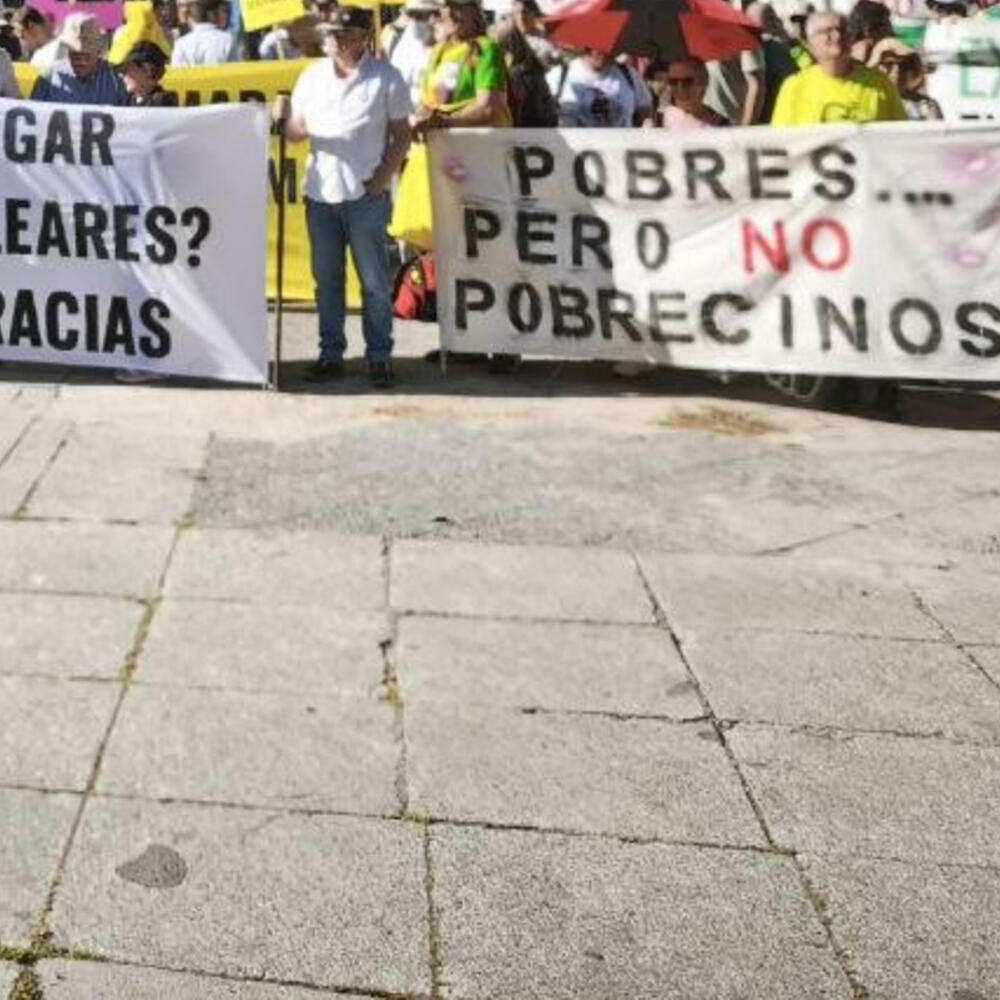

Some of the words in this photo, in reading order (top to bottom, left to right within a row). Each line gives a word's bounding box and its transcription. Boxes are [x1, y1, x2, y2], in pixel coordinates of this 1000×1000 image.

[464, 208, 670, 271] PERO
[741, 217, 852, 273] NO
[454, 279, 1000, 357] POBRECINOS
